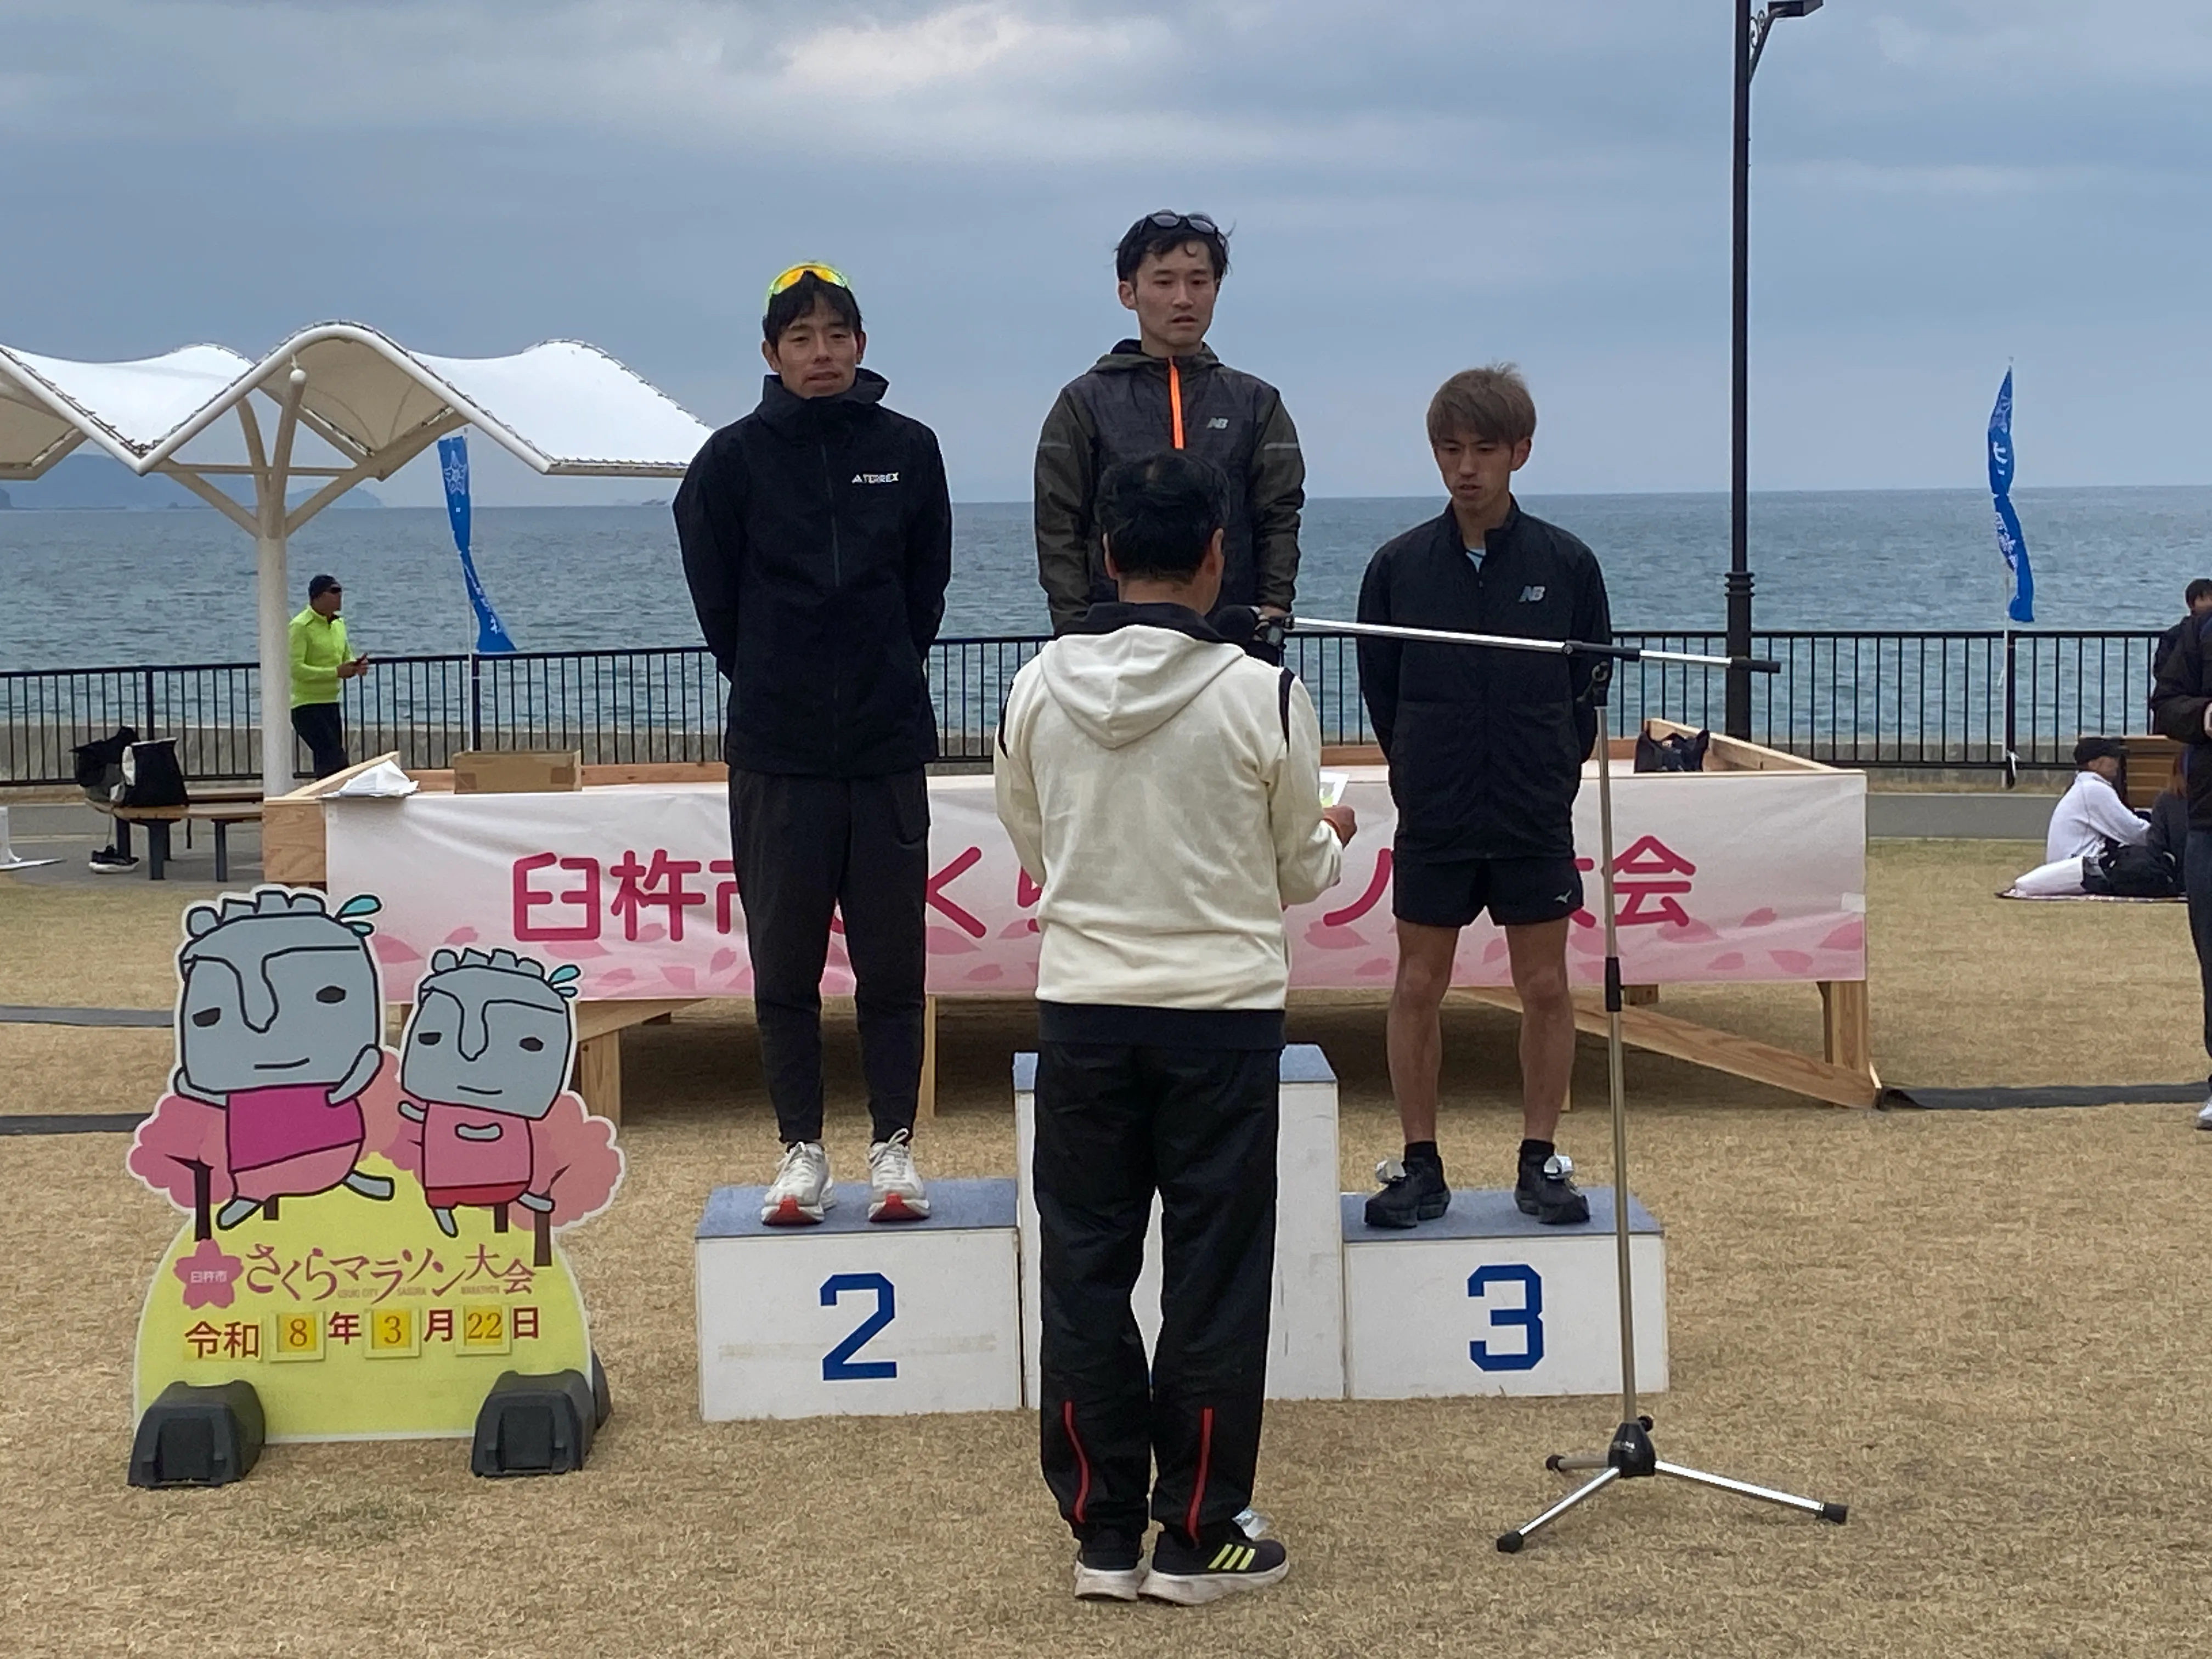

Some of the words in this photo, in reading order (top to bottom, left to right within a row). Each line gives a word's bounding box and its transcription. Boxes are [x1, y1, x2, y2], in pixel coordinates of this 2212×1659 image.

[246, 1242, 535, 1304] さくらマラソン大会
[820, 1272, 897, 1380] 2
[1468, 1263, 1543, 1371] 3
